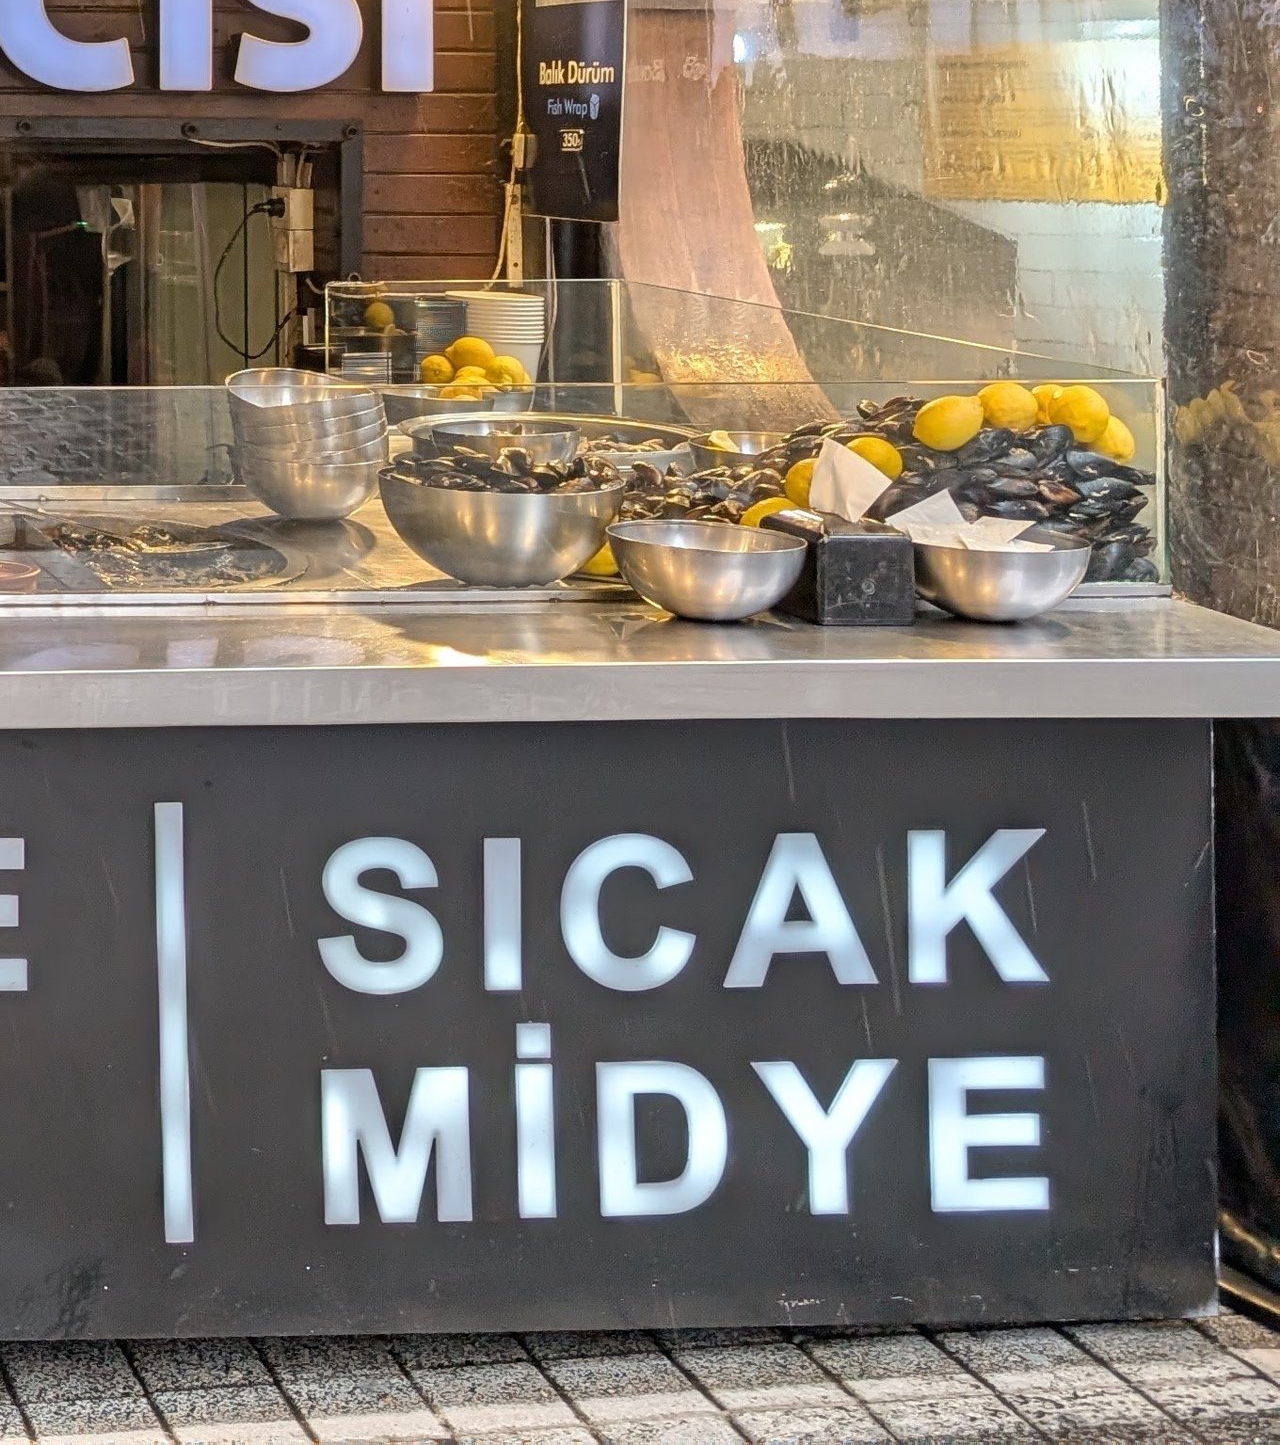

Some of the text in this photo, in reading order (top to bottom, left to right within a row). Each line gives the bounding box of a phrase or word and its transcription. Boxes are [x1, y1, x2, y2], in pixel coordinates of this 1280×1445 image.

[539, 59, 615, 85] Balık Dürüm
[547, 98, 588, 119] Fish Wrap
[317, 828, 1051, 995] SICAK
[321, 1022, 1051, 1225] MİDYE
